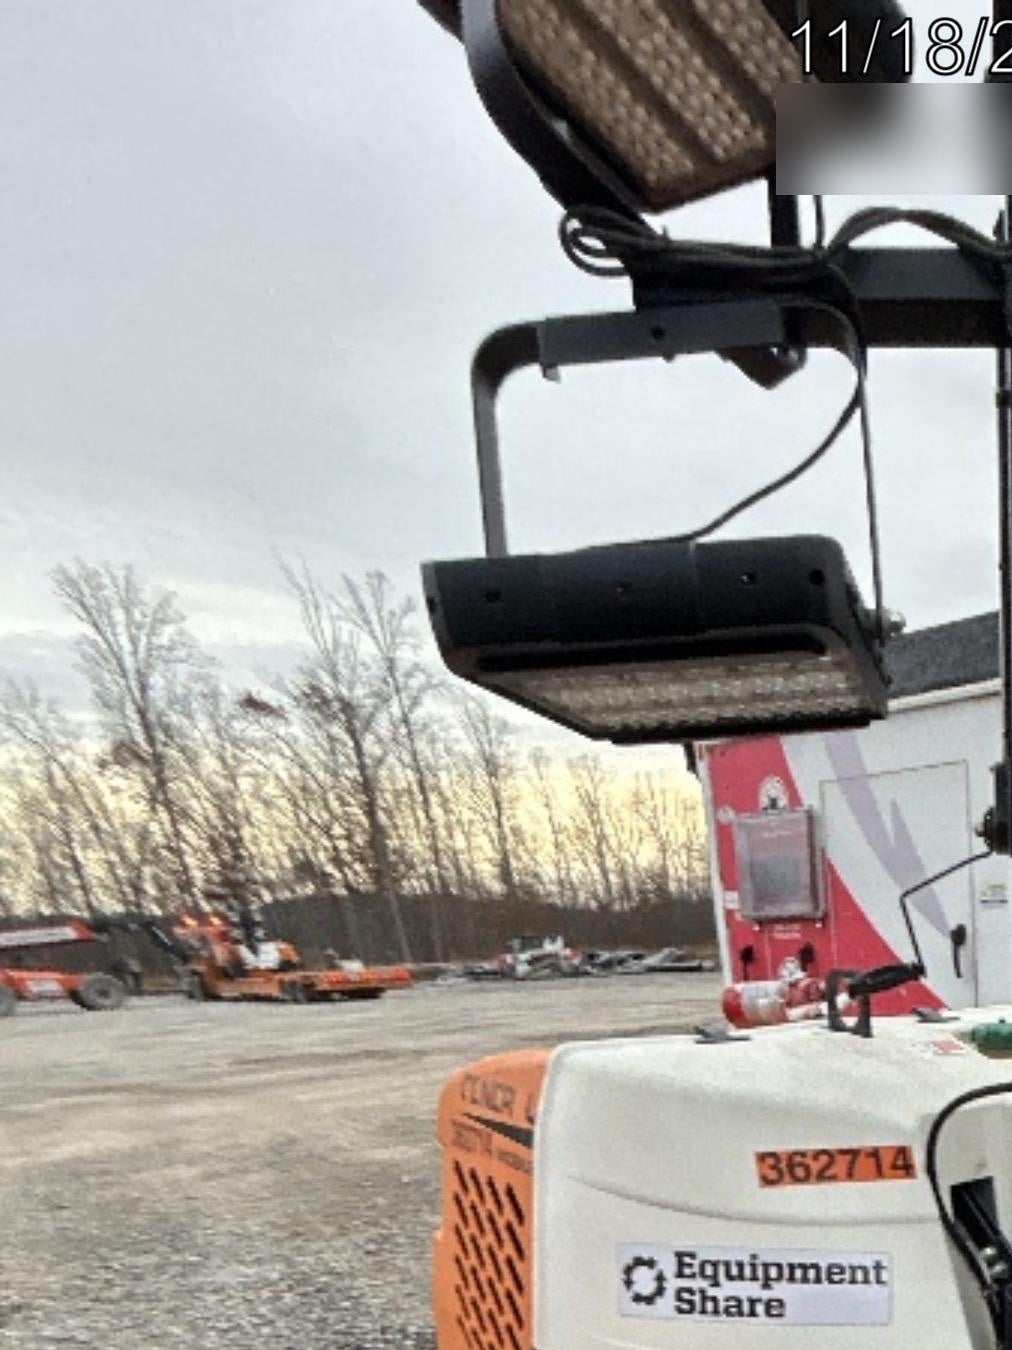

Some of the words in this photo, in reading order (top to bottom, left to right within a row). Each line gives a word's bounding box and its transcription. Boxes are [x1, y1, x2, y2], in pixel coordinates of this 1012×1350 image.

[757, 1146, 915, 1186] 362714
[674, 1250, 888, 1290] Equipment
[674, 1286, 786, 1318] Share
